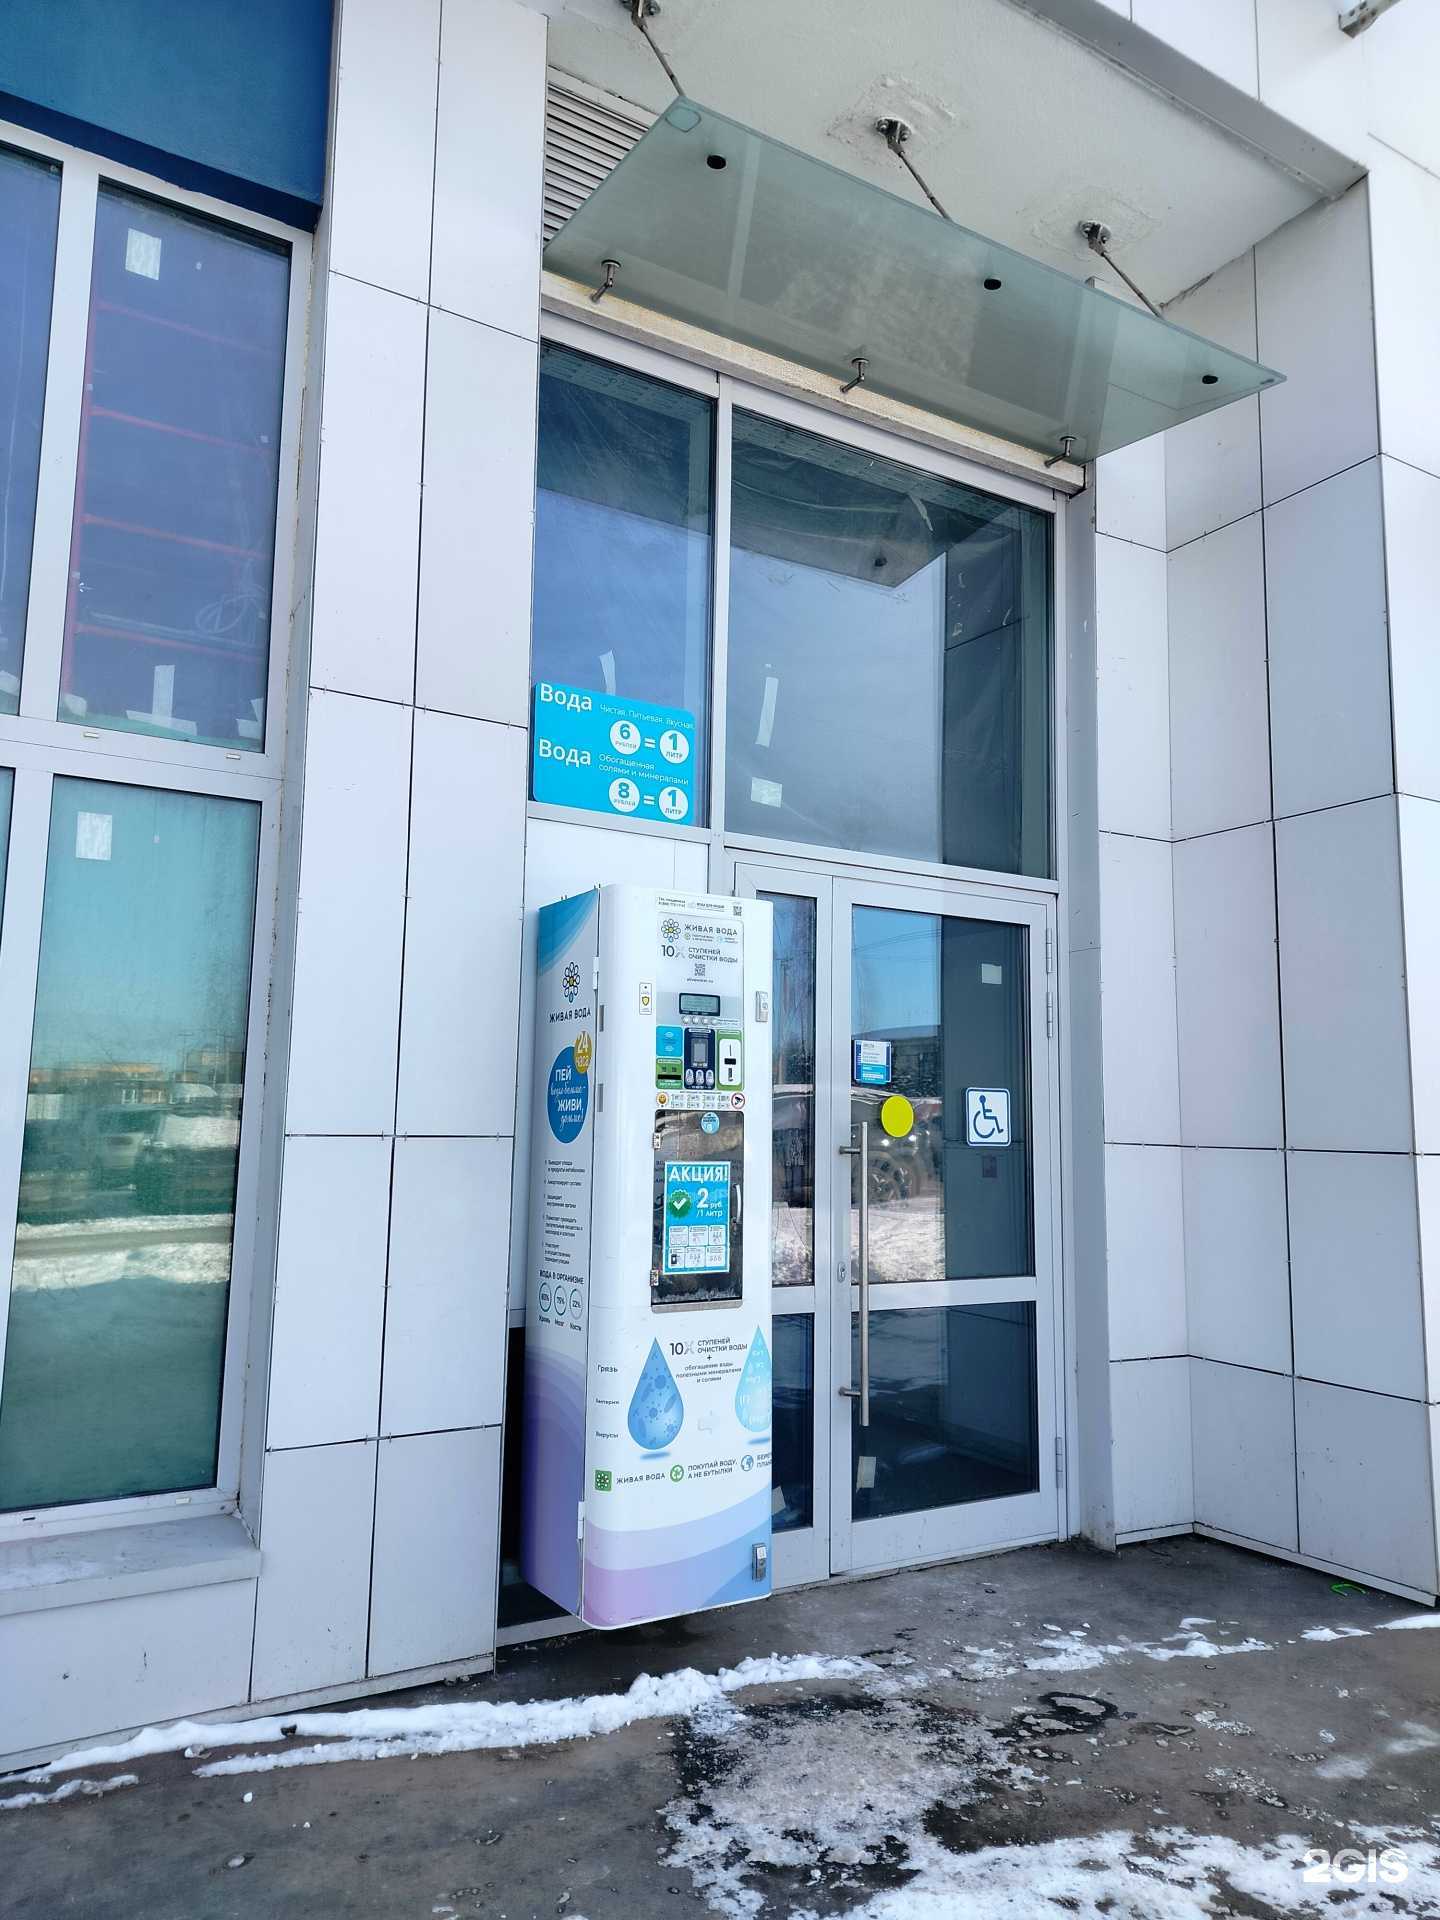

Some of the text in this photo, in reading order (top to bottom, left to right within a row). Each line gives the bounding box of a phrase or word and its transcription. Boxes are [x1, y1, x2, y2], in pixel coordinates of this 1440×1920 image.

[540, 683, 592, 712] Вода
[620, 724, 631, 740] 6
[668, 733, 678, 750] 1
[539, 739, 591, 767] Вода
[598, 764, 630, 775] солями
[618, 782, 630, 798] 8
[667, 790, 677, 807] 1
[685, 924, 738, 936] ЖИВАЯ ВОДА
[688, 946, 721, 955] СТУПЕНЕЙ
[688, 953, 718, 962] ОЧИСТКИ
[549, 1007, 591, 1023] ЖИВАЯ ВОДА
[577, 1032, 588, 1054] 24
[555, 1065, 572, 1082] ПЕЙ
[557, 1098, 582, 1112] ЖИВИ
[668, 1166, 728, 1183] АКЦИЯ!
[696, 1188, 709, 1209] 2
[557, 1272, 585, 1285] ОРГАНИЗМЕ
[697, 1337, 731, 1346] СТУПЕНЕЙ
[697, 1343, 748, 1354] ОЧИСТКИ ВОДЫ
[597, 1364, 618, 1374] Грязь
[687, 1461, 719, 1472] ПОКУПАЙ
[693, 1471, 702, 1479] НЕ
[703, 1467, 733, 1478] БУТЫЛКИ
[616, 1472, 666, 1485] ЖИВАЯ ВОДА
